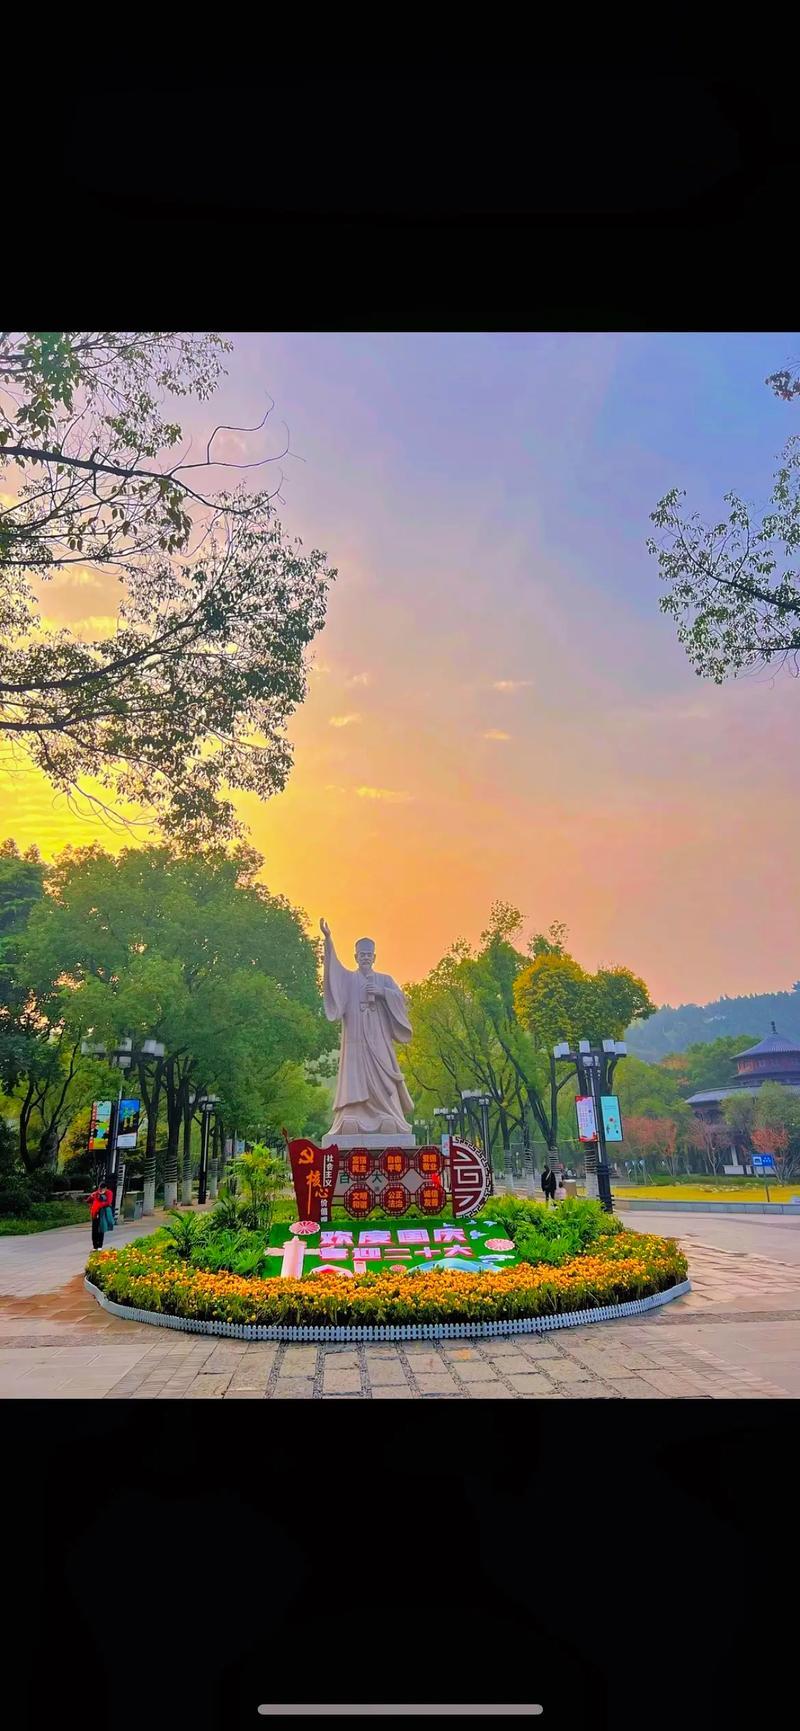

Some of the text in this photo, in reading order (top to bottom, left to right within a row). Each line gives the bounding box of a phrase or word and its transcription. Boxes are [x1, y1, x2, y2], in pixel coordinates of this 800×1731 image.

[306, 1170, 329, 1198] 核心
[319, 1227, 467, 1246] 欢度国庆
